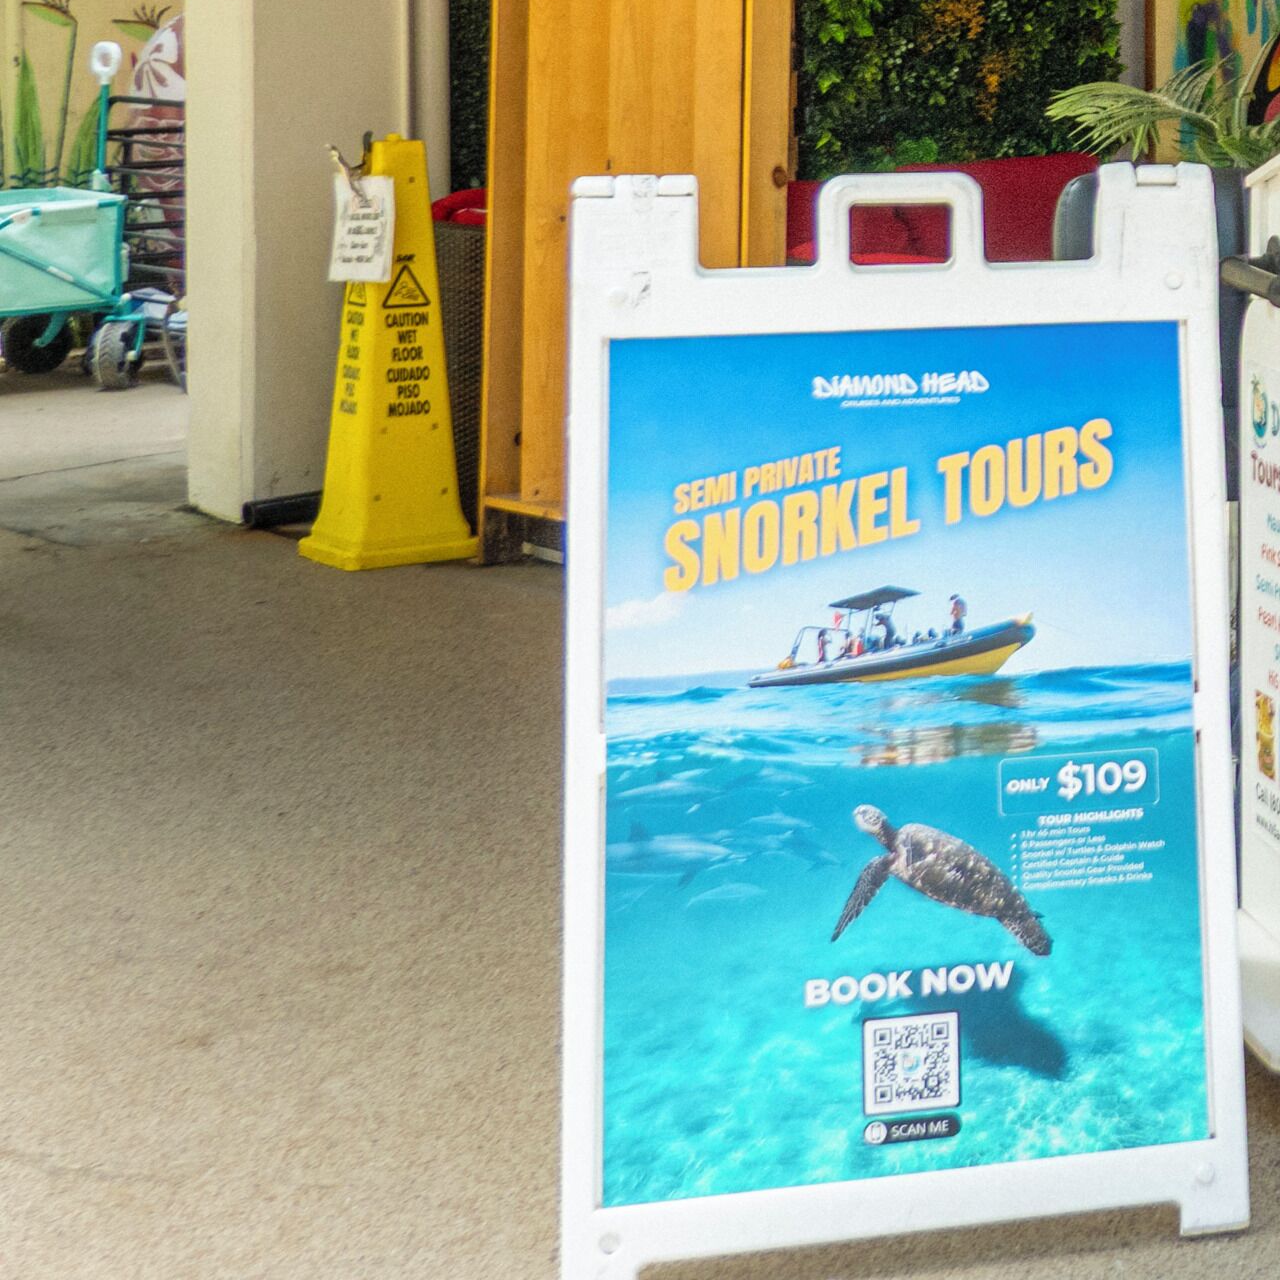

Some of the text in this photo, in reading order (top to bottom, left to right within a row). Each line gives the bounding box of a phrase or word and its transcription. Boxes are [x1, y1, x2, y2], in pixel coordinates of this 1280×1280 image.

[385, 312, 429, 328] CAUTION
[398, 330, 417, 343] WET
[392, 346, 424, 361] FLOOR
[387, 366, 430, 382] CUIDADO
[397, 384, 420, 398] PISO
[812, 370, 990, 398] DIAMOND HEAD
[387, 400, 431, 417] MOJADO
[674, 446, 841, 514] SEMI PRIVATE
[664, 417, 1114, 593] SNORKEL TOURS
[1006, 758, 1147, 800] ONLY $109
[1038, 808, 1144, 826] TOUR HIGHLIGHTS
[1068, 826, 1090, 834] Tours
[1022, 849, 1053, 859] Snorkel
[1068, 845, 1095, 855] Turtles
[1105, 841, 1136, 853] Dolphin
[1138, 839, 1165, 849] Watch
[1029, 838, 1076, 850] Passengers
[1088, 835, 1105, 843] Less
[1023, 858, 1057, 869] Certified
[1059, 856, 1091, 868] Captain
[1101, 854, 1124, 862] Guide
[1023, 861, 1144, 881] Quality Snorkel Gear Provided
[1023, 876, 1086, 891] Complimentary
[1088, 874, 1117, 884] Snacks
[1126, 871, 1153, 881] Drinks
[804, 960, 1015, 1008] BOOK NOW
[891, 1119, 949, 1138] SCAN ME
